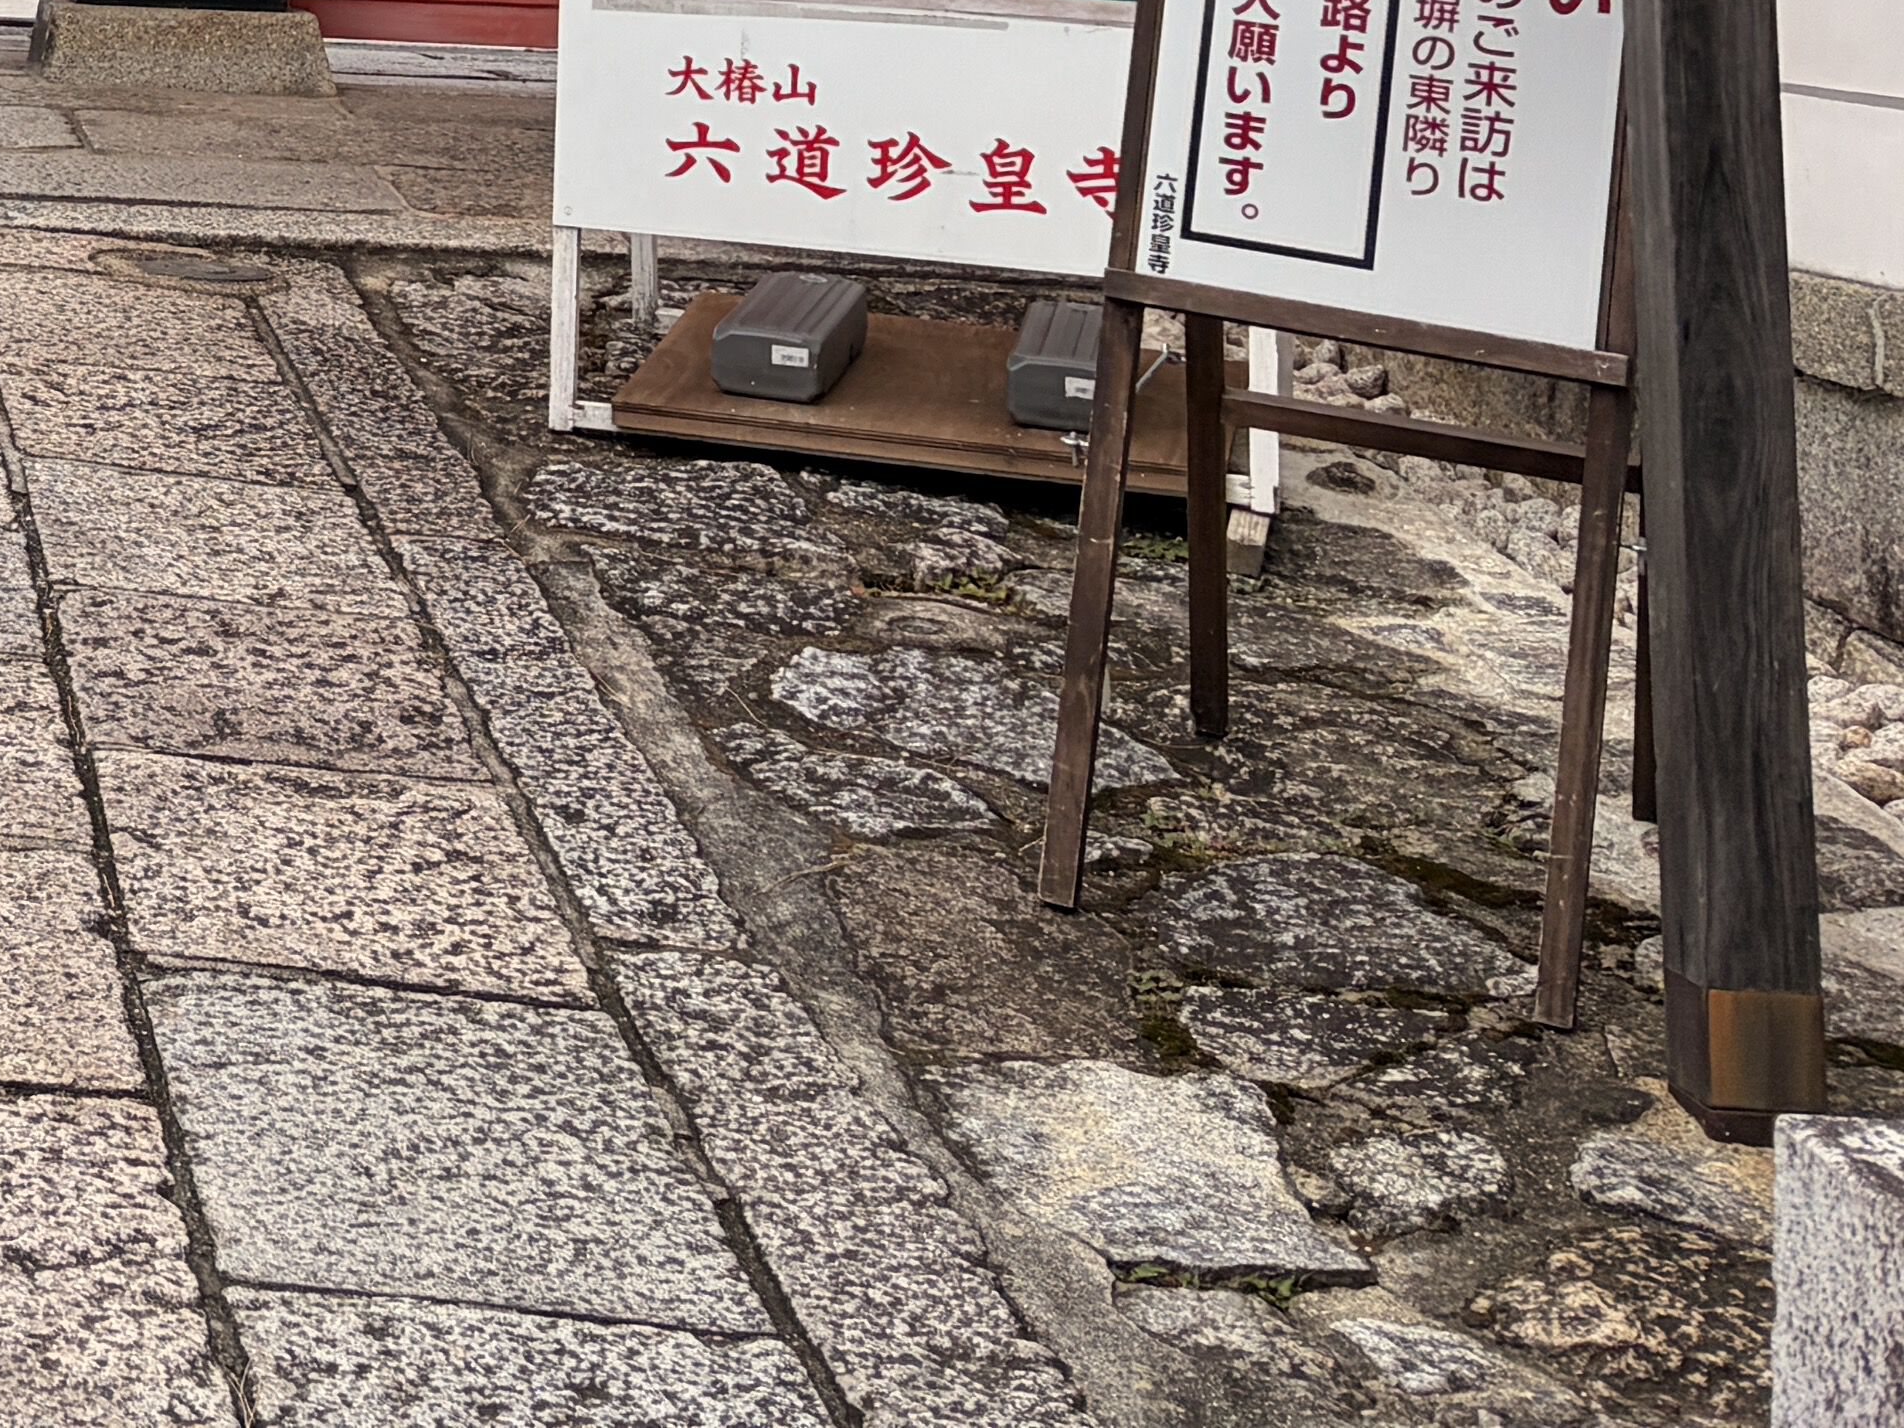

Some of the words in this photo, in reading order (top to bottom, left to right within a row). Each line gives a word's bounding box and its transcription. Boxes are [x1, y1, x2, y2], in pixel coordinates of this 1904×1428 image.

[666, 55, 816, 106] 大椿山
[665, 122, 1120, 221] 六道珍皇寺
[1148, 173, 1178, 273] 六道珍皇寺
